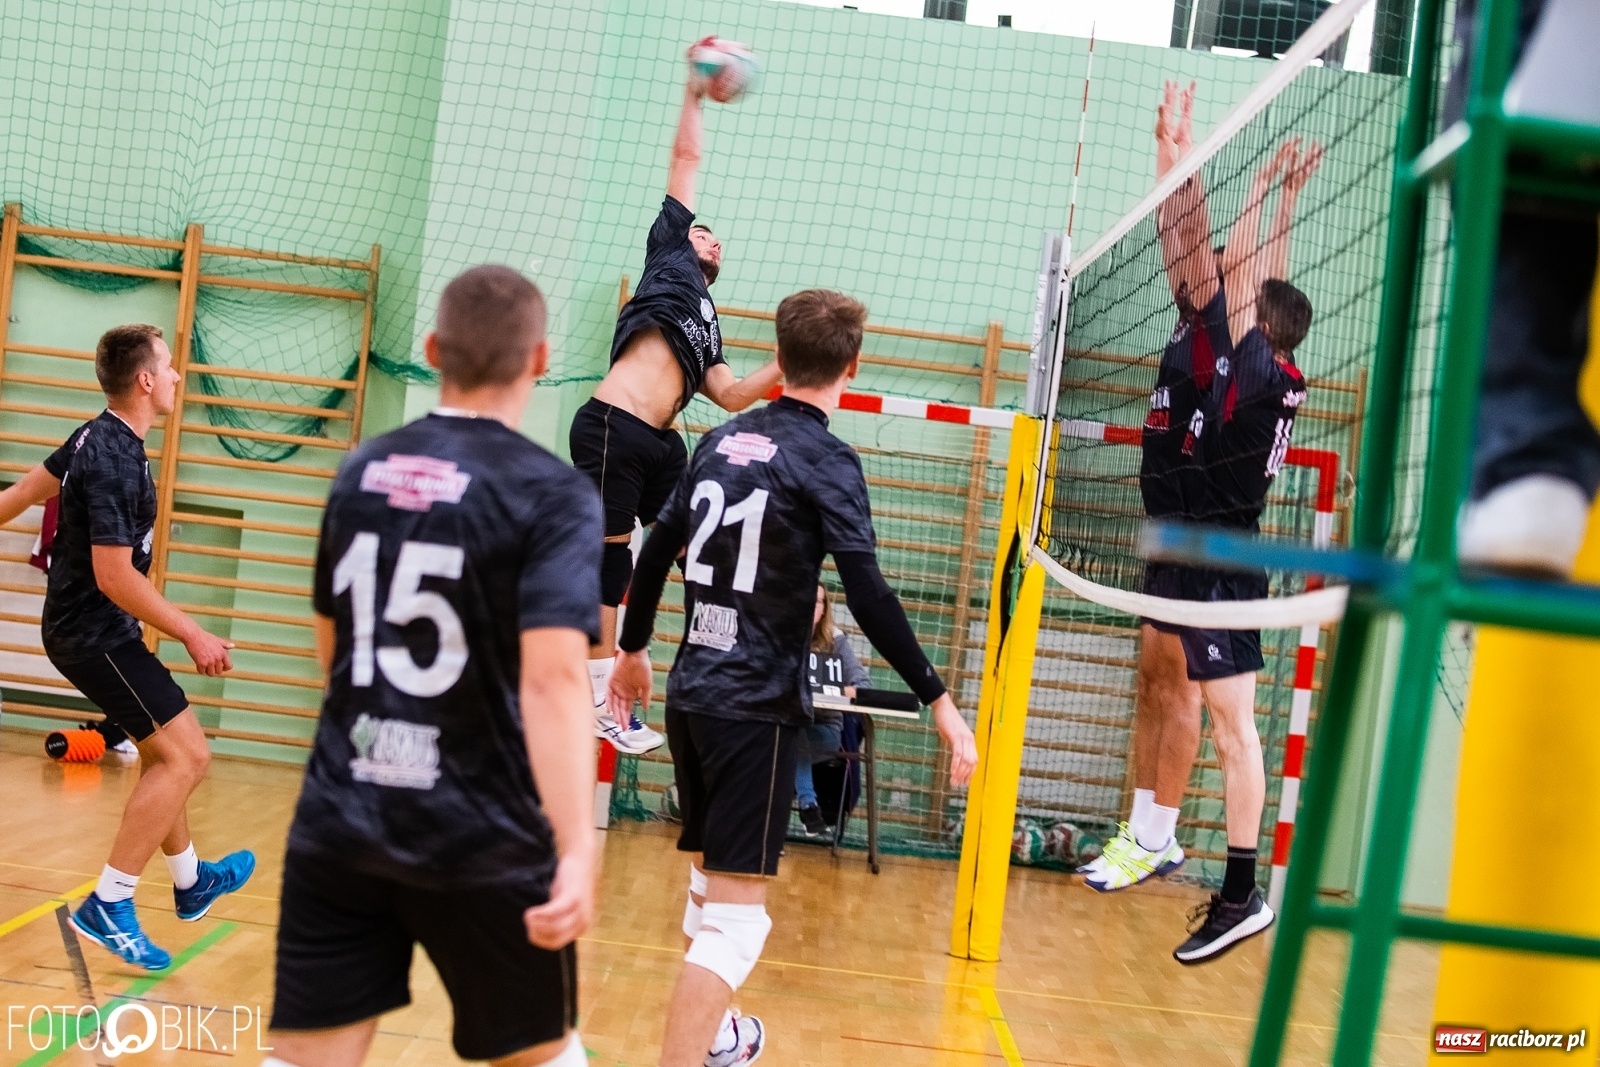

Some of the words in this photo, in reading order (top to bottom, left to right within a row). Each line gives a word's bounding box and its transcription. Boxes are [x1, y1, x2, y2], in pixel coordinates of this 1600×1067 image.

[685, 479, 770, 594] 21
[332, 531, 471, 698] 15
[824, 657, 843, 683] 11
